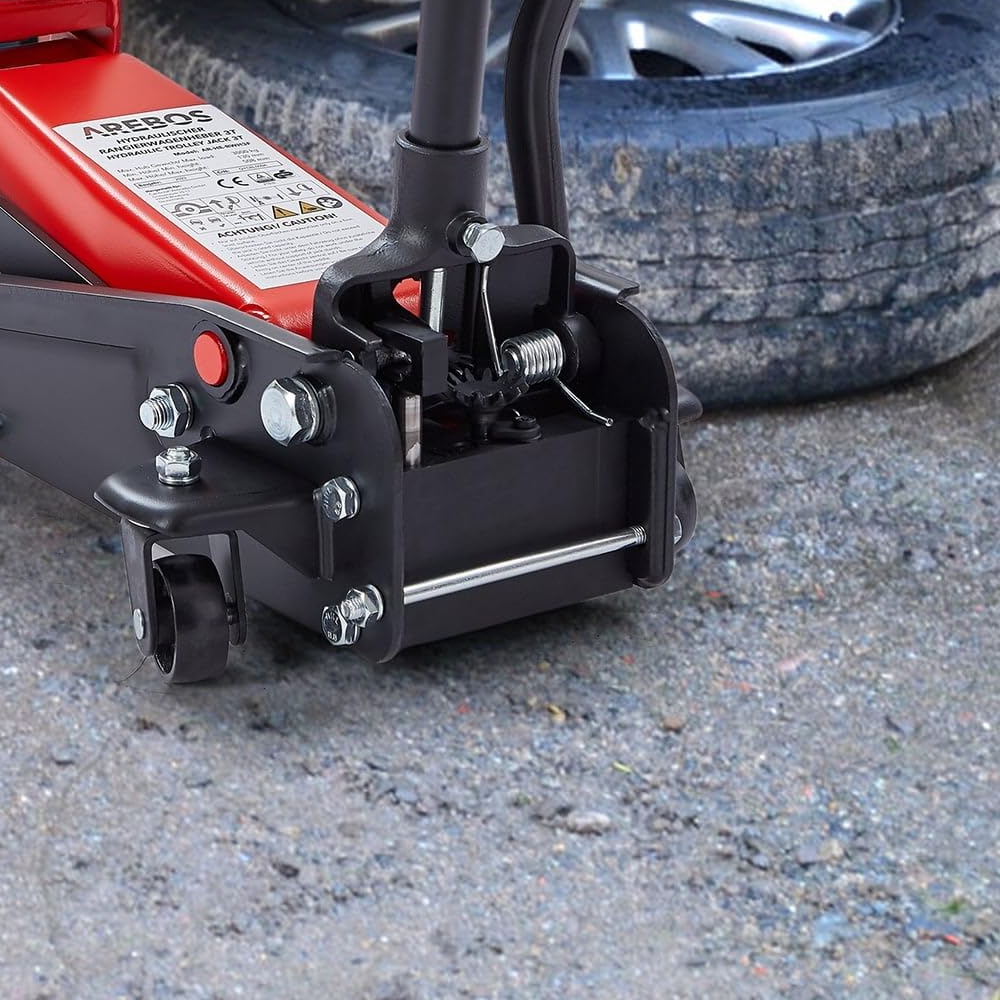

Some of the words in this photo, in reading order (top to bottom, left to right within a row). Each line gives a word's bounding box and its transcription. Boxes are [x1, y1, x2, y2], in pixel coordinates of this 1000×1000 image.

[84, 110, 213, 140] AREBOS
[115, 126, 205, 144] HYDRAULISCHER
[97, 131, 222, 154] RANGIERWAGENHEBER
[105, 147, 163, 159] HYDRAULIC
[163, 140, 205, 150] TROLLEY
[204, 136, 230, 144] JACK
[281, 212, 338, 227] CAUTION!
